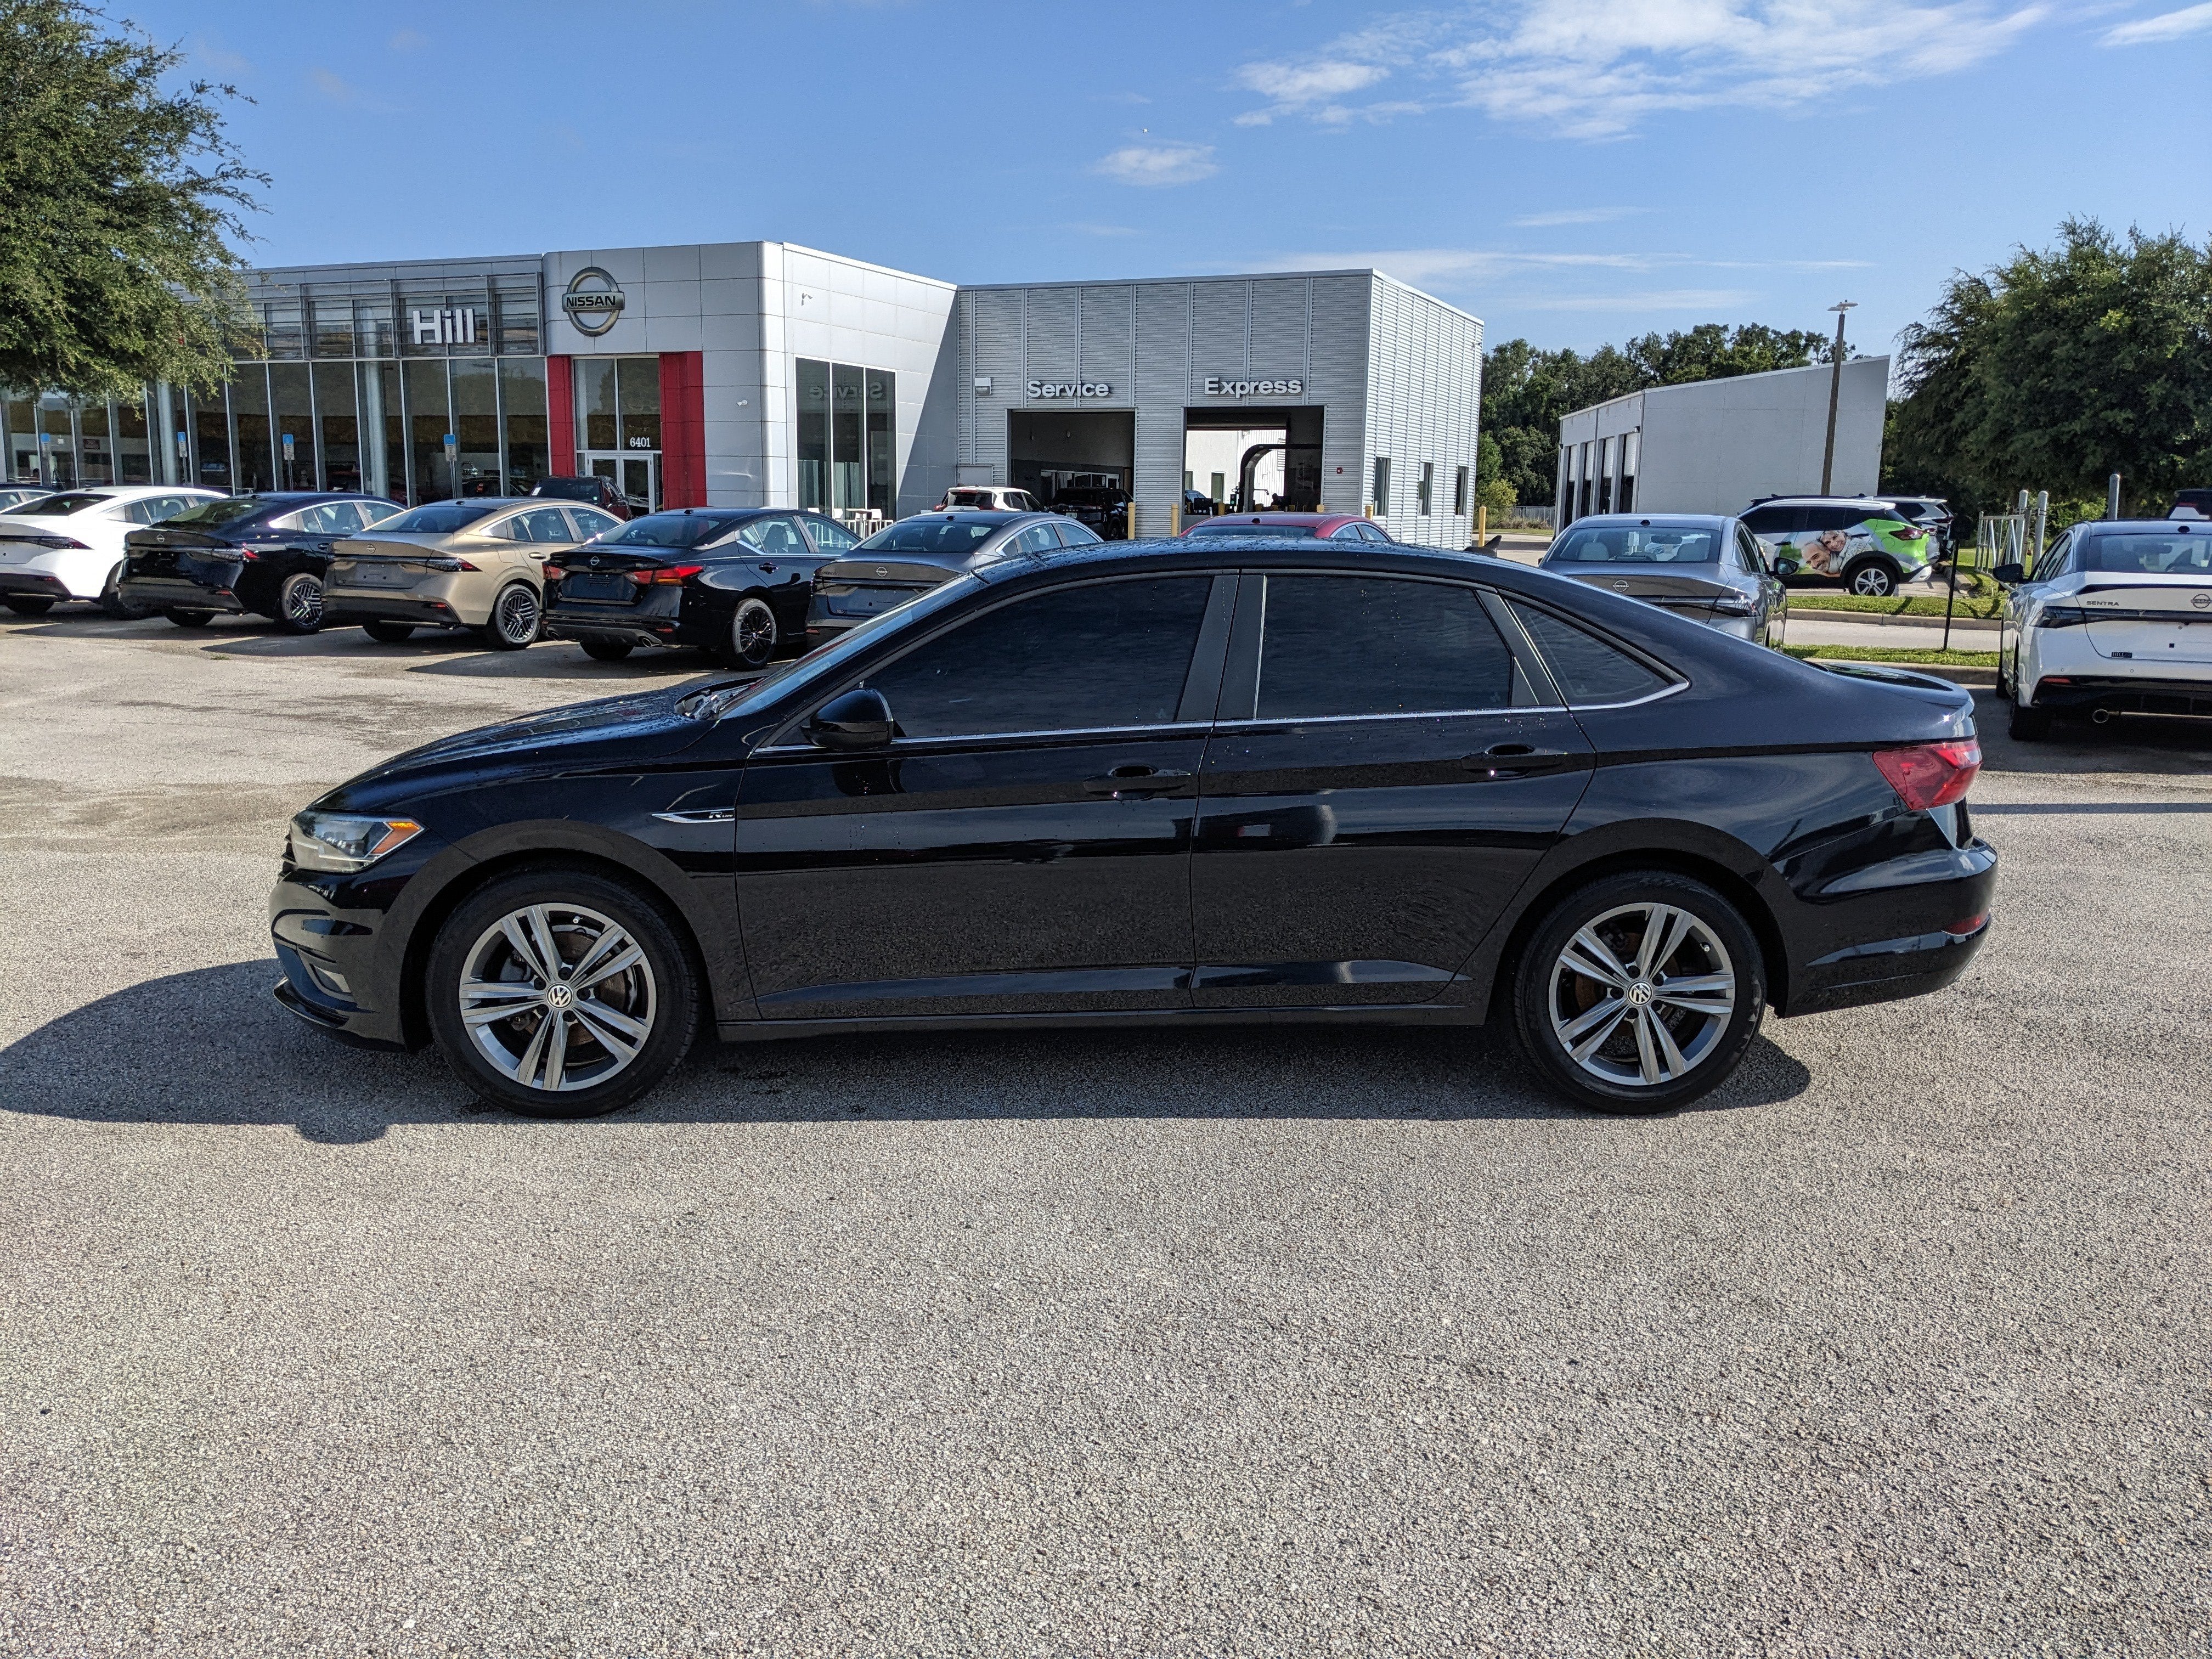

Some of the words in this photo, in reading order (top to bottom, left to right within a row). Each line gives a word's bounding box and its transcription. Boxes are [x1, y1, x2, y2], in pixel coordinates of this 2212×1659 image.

[566, 296, 616, 307] NISSAN
[413, 308, 475, 344] Hill
[1027, 380, 1109, 397] Service
[1204, 377, 1302, 398] Express
[630, 437, 651, 447] 6401
[548, 984, 572, 1008] VW
